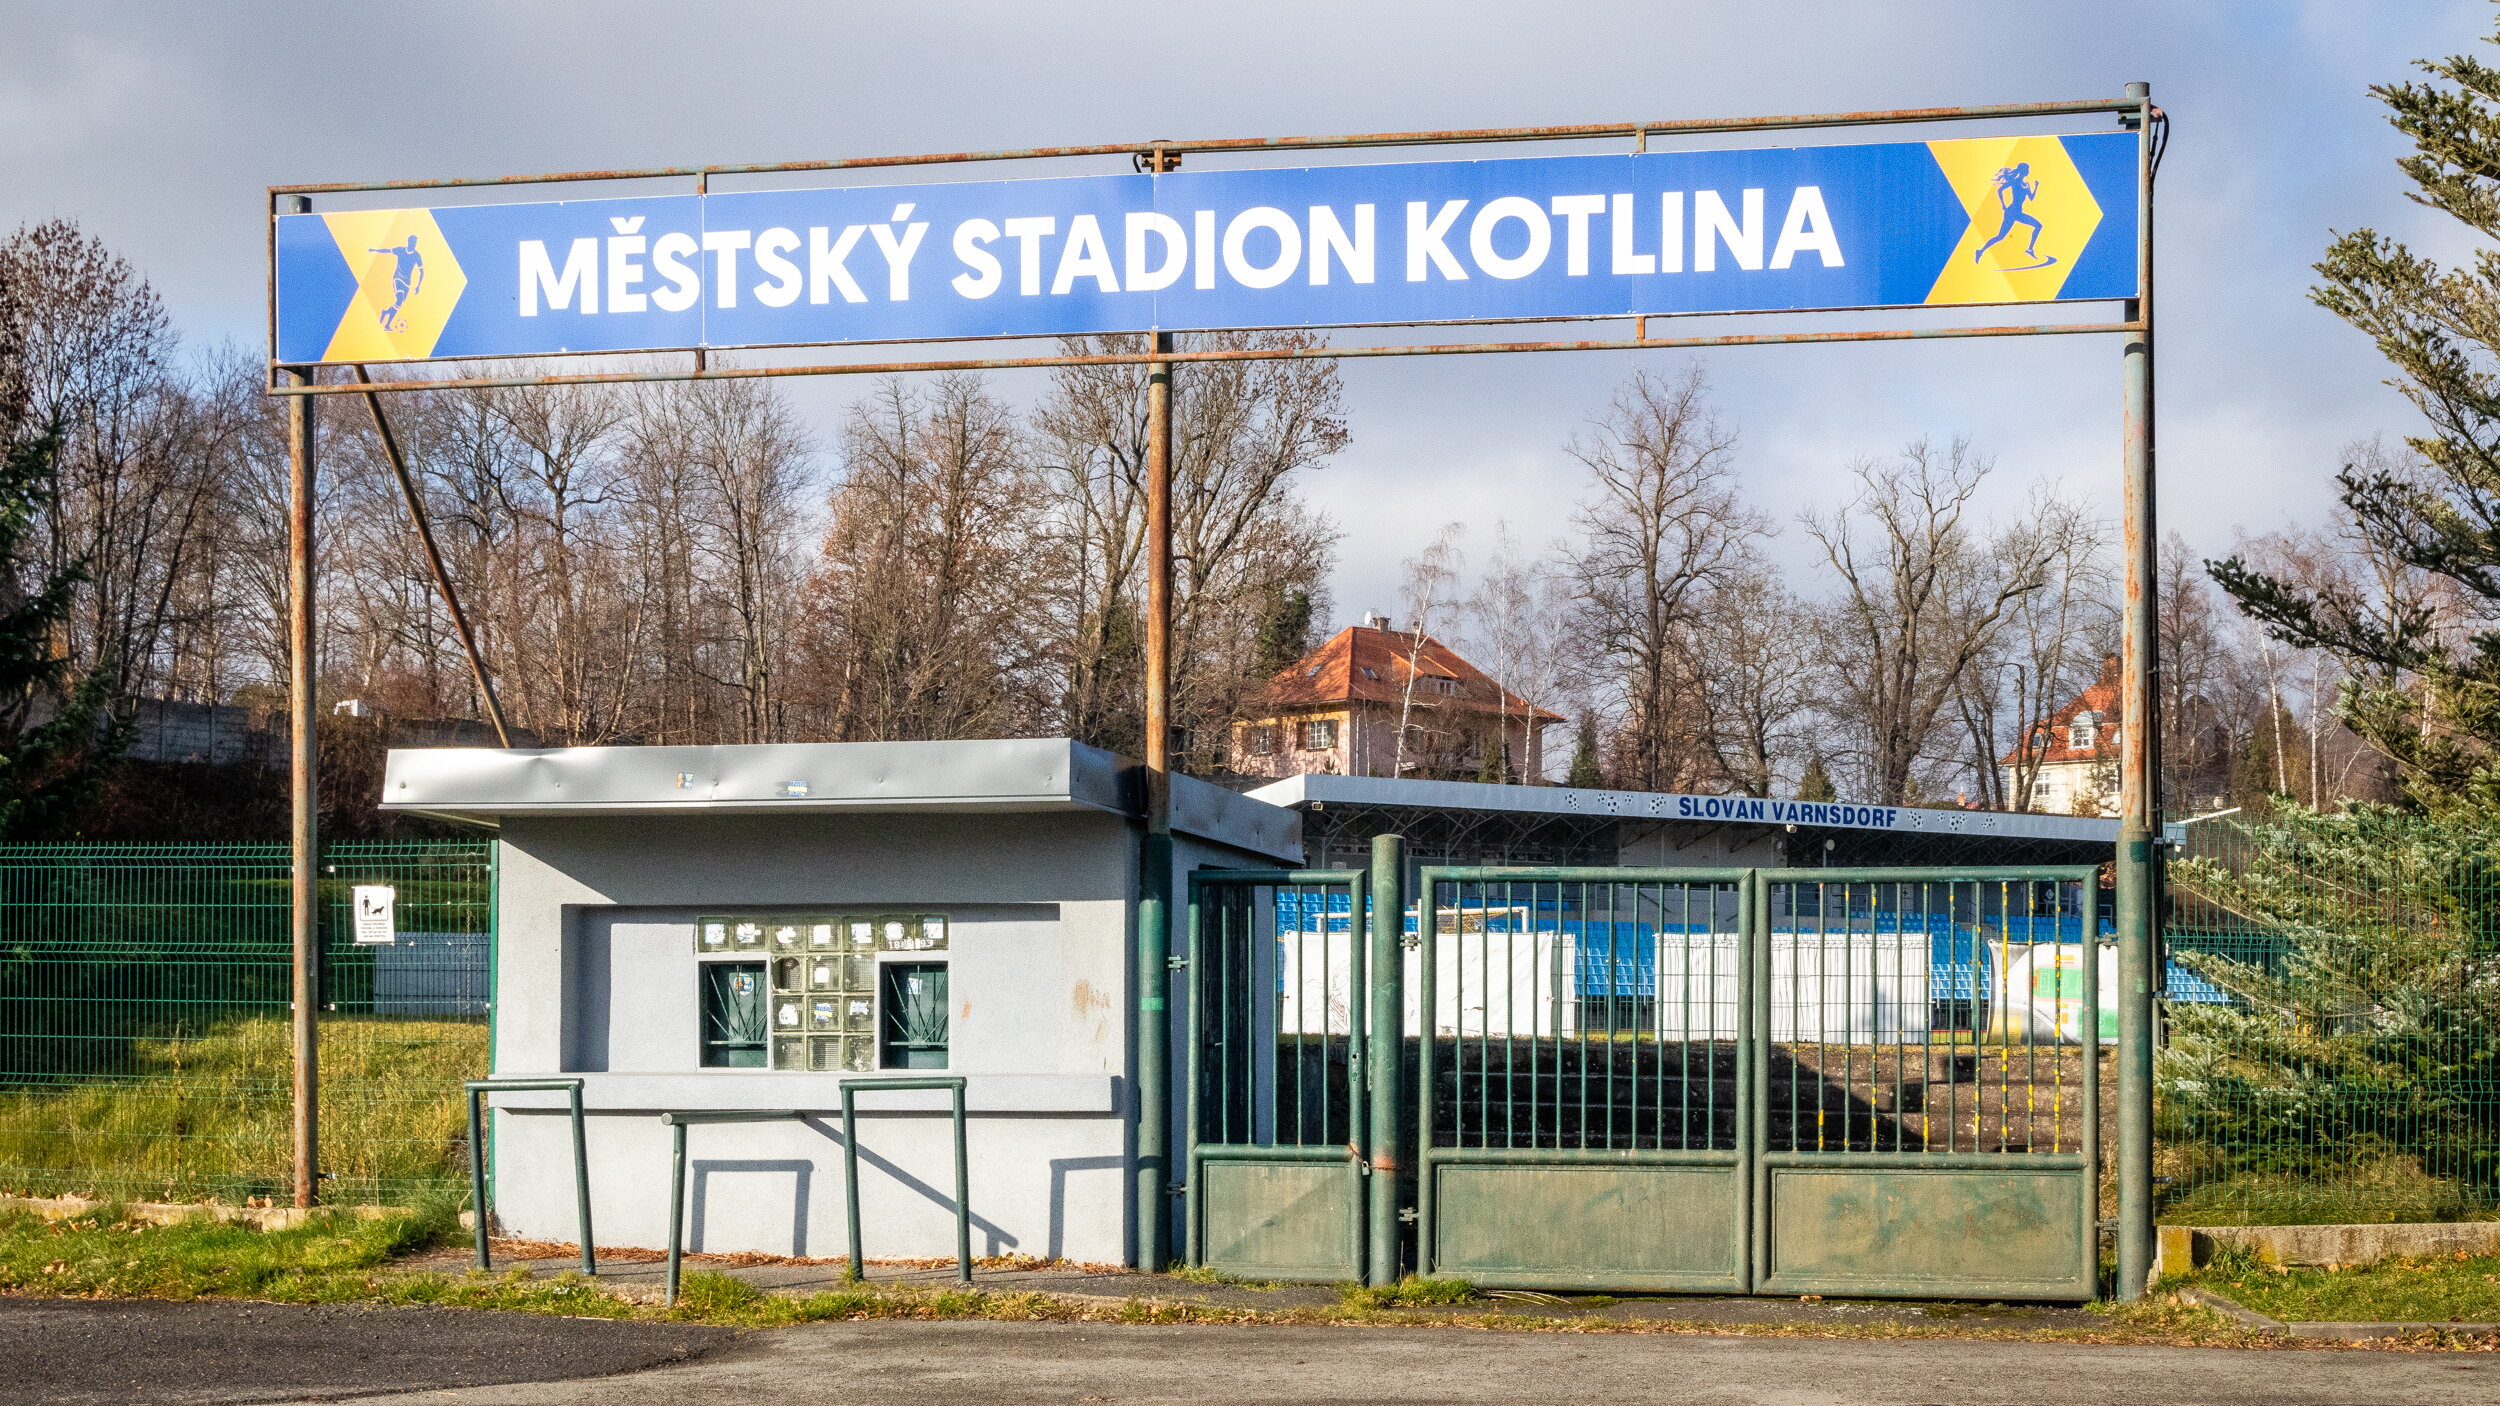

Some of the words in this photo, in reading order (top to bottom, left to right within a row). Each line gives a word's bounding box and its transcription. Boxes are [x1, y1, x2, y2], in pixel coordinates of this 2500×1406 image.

[519, 203, 930, 317] MĚSTSKÝ
[951, 203, 1377, 299] STADION
[1406, 186, 1845, 282] KOTLINA
[1678, 796, 1764, 820] SLOVAN
[1772, 801, 1897, 827] VARNSDORF
